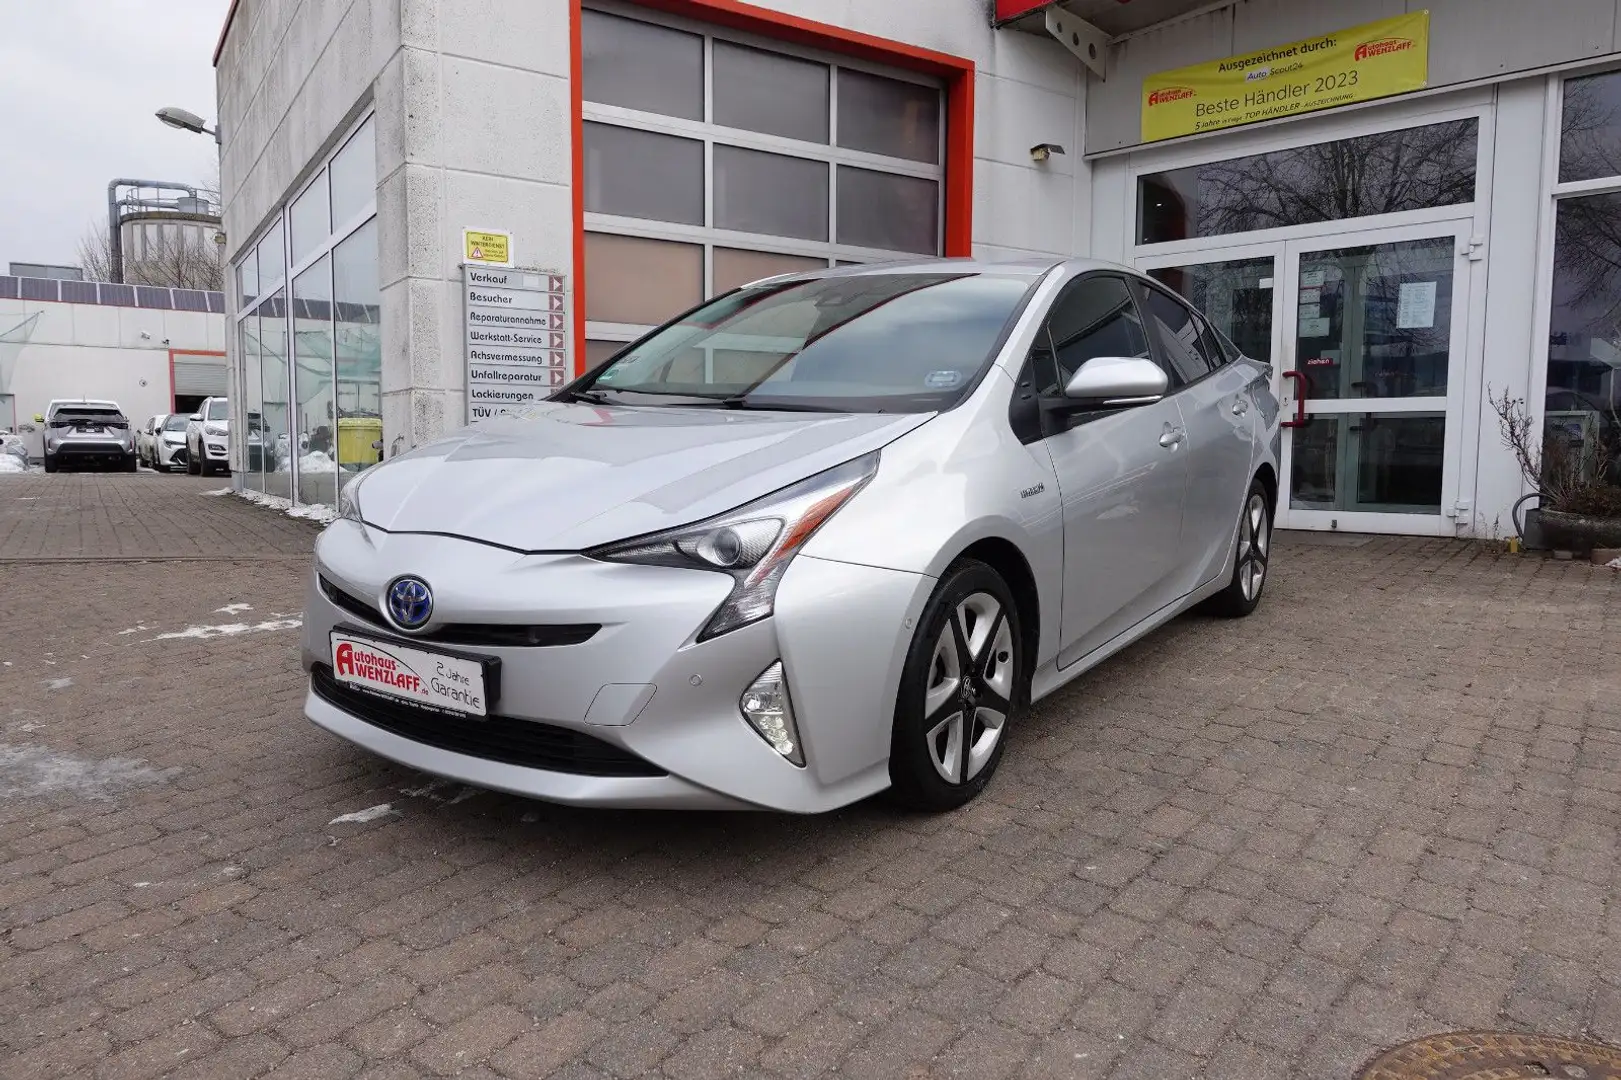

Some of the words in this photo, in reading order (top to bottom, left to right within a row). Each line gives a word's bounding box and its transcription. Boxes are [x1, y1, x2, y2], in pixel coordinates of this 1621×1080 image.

[1218, 46, 1298, 73] Ausgezeichnet
[1300, 37, 1337, 55] durch:
[1368, 41, 1412, 57] WENZLAFF
[1195, 97, 1240, 117] Beste
[1244, 81, 1310, 108] Händler
[1315, 70, 1359, 94] 2023
[1195, 122, 1201, 131] 5
[1245, 110, 1261, 120] TOP
[1262, 102, 1300, 116] HÄNDLER
[470, 272, 508, 285] Verkauf
[470, 291, 512, 304] Besucher
[470, 312, 547, 326] Reparaturannahme
[470, 332, 542, 344] Werkstatt-Service
[470, 351, 543, 364] Achsvermessung
[471, 370, 542, 382] Unfallreparatur
[472, 389, 534, 401] Lackierungen
[472, 406, 491, 417] TÜV
[336, 643, 397, 677] Autohaus
[354, 663, 420, 693] WENZLAFF
[436, 661, 445, 676] 2
[447, 669, 470, 686] Jahre
[431, 677, 480, 709] Garantie
